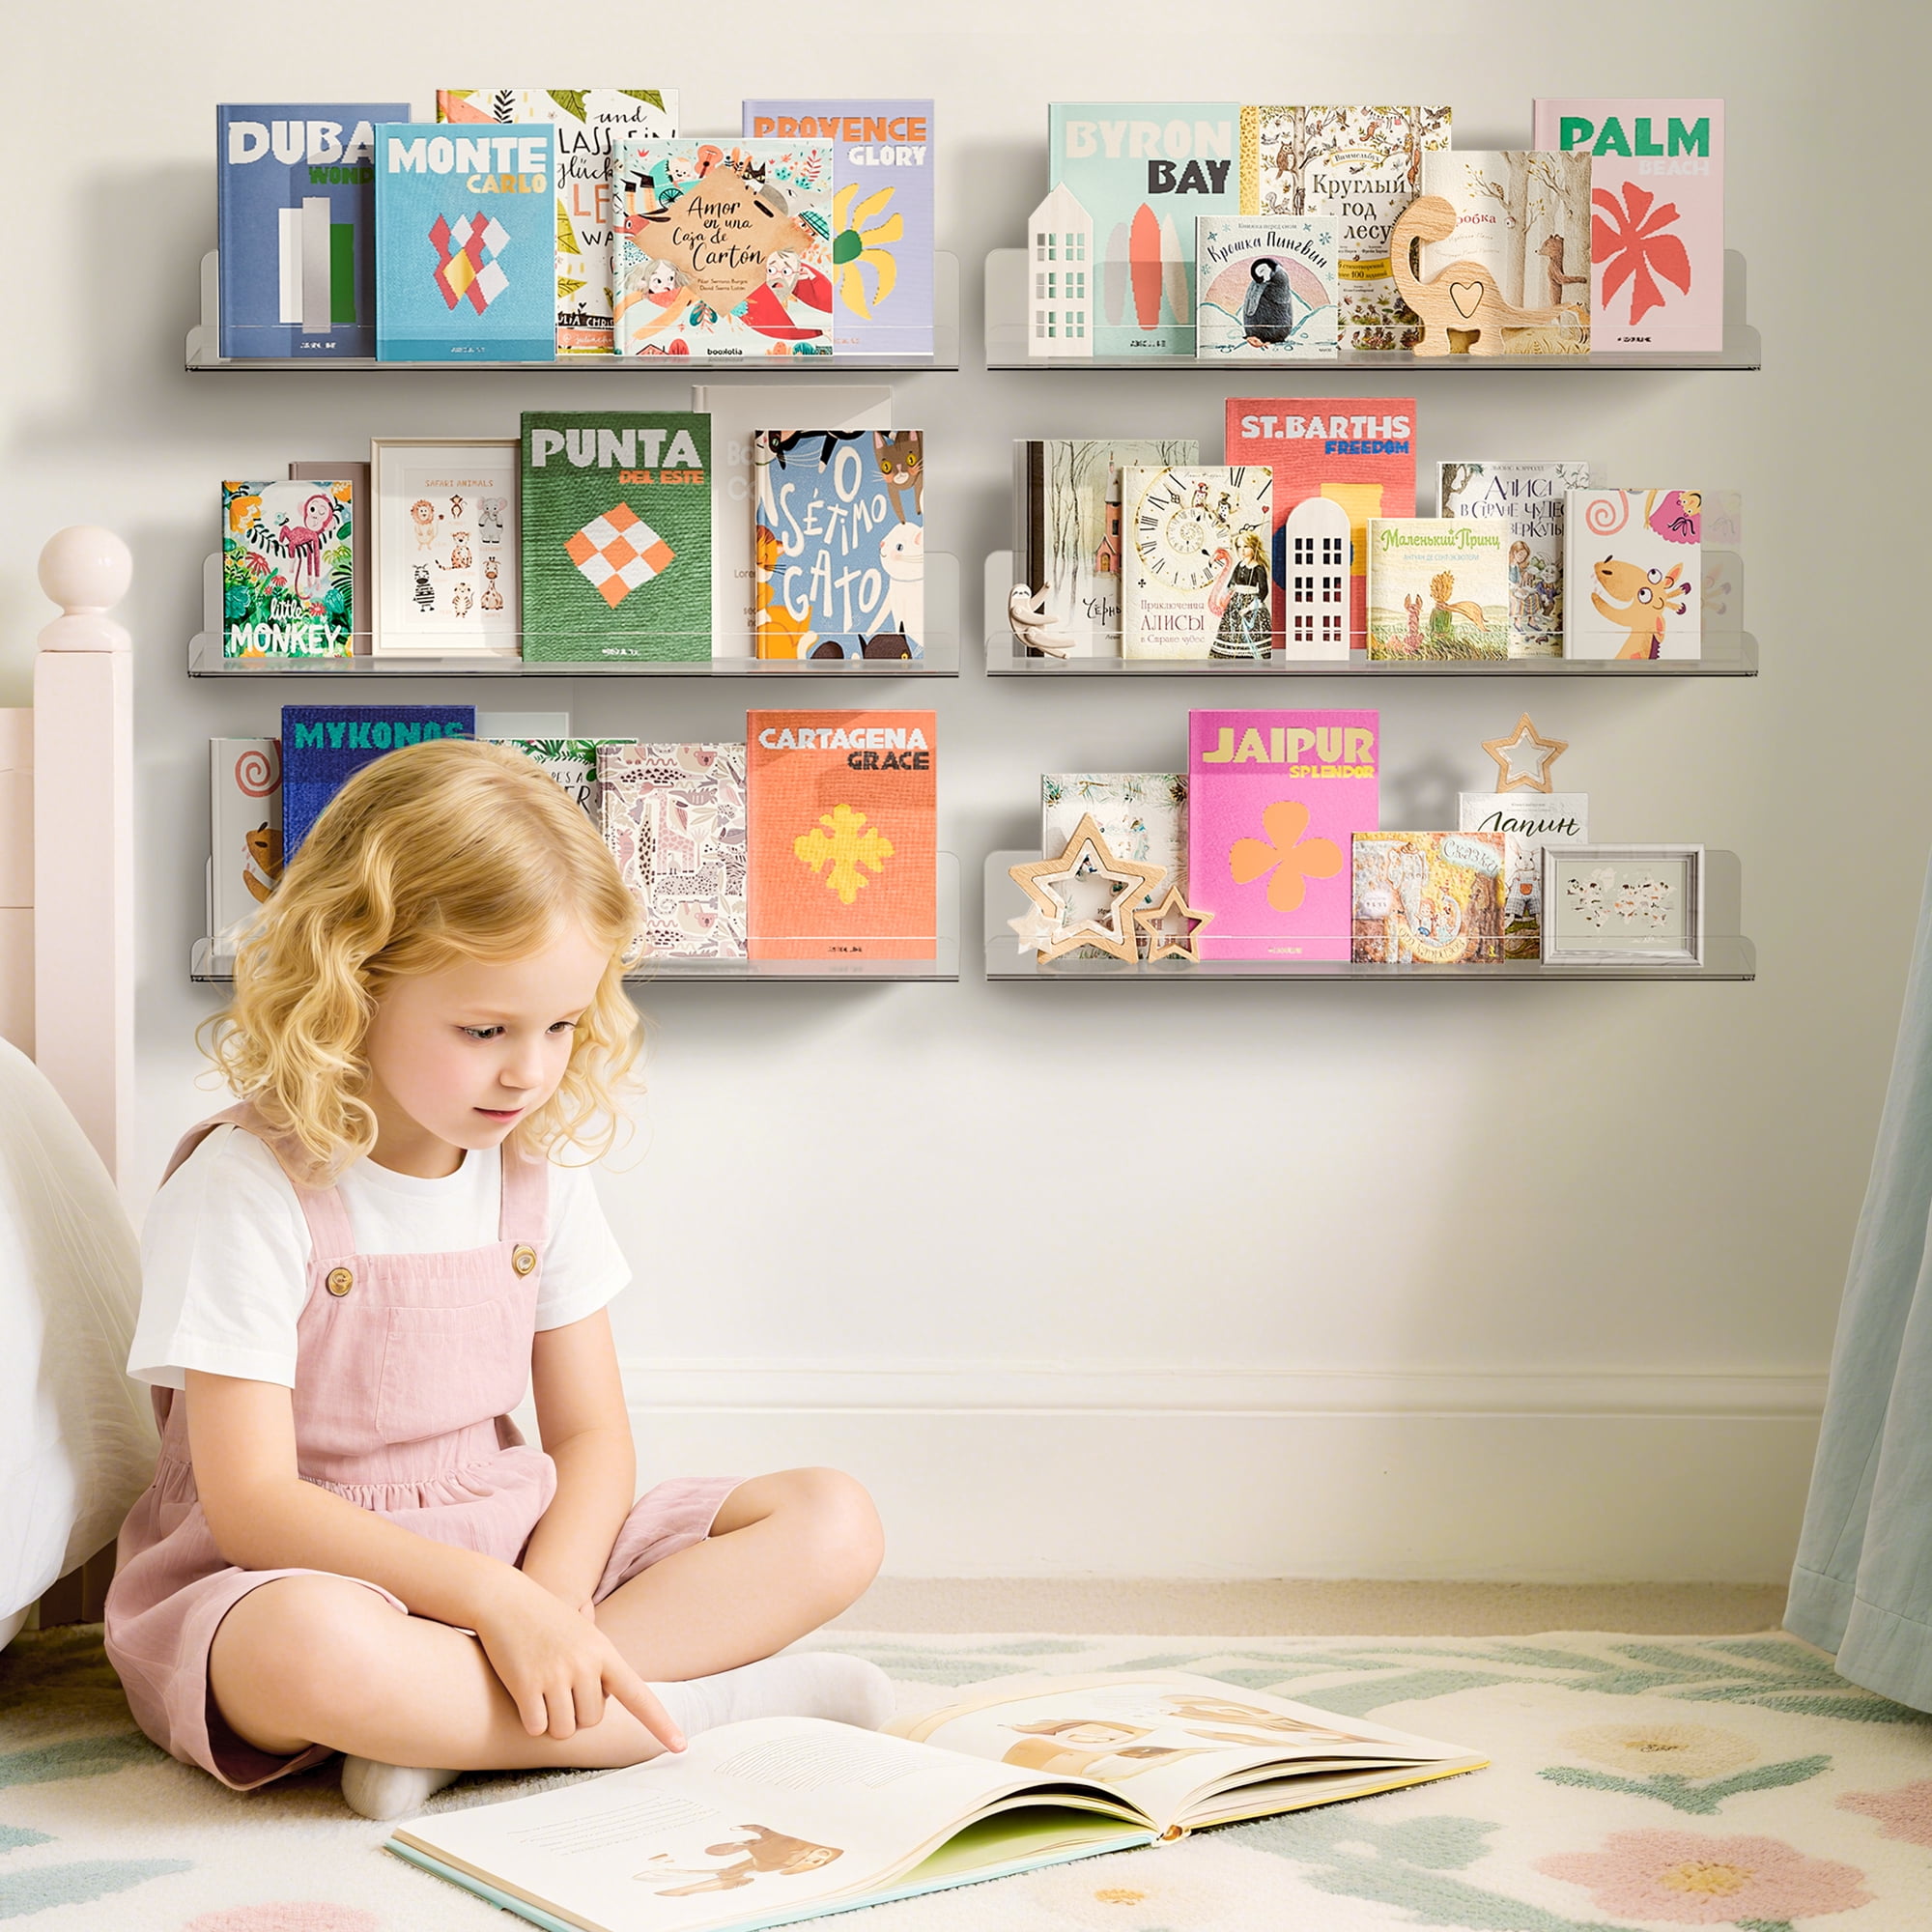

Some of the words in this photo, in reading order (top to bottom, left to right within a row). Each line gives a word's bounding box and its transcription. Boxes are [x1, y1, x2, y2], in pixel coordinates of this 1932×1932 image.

[594, 105, 647, 123] und
[559, 127, 611, 155] LASS
[753, 116, 926, 142] PROVENCE
[1065, 120, 1231, 158] BYRON
[1560, 117, 1710, 156] PALM
[228, 121, 402, 164] DUBA
[388, 136, 548, 174] MONTE
[848, 145, 926, 165] GLORY
[1149, 160, 1232, 193] BAY
[1638, 160, 1710, 176] BEACH
[467, 174, 548, 193] CARLO
[1312, 172, 1406, 199] Круглый
[687, 196, 741, 219] Amor
[1342, 202, 1377, 220] год
[703, 218, 721, 229] en
[724, 218, 753, 230] una
[1344, 224, 1391, 244] лесу
[672, 226, 705, 250] Caja
[710, 228, 727, 243] de
[1207, 238, 1262, 263] Крошка
[1266, 231, 1328, 269] Пингвин
[693, 242, 766, 271] Cartón
[1240, 415, 1411, 439] ST.BARTHS
[531, 429, 703, 468] PUNTA
[1324, 440, 1409, 455] FREEDOM
[619, 469, 654, 484] DEL
[660, 469, 704, 484] ESTE
[834, 445, 863, 503] O
[1380, 528, 1455, 552] Маленький
[1455, 527, 1501, 550] Принц
[783, 549, 882, 634] GATO
[269, 597, 304, 620] little
[1141, 599, 1205, 612] Приключения
[1141, 614, 1205, 631] АЛИСЫ
[231, 623, 342, 654] MONKEY
[295, 721, 466, 749] MYKONOS
[758, 727, 928, 750] CARTAGENA
[1203, 726, 1376, 763] JAIPUR
[847, 752, 929, 770] GRACE
[1290, 765, 1375, 779] SPLENDOR
[1478, 810, 1580, 838] Лапин
[1443, 839, 1498, 875] Сказки
